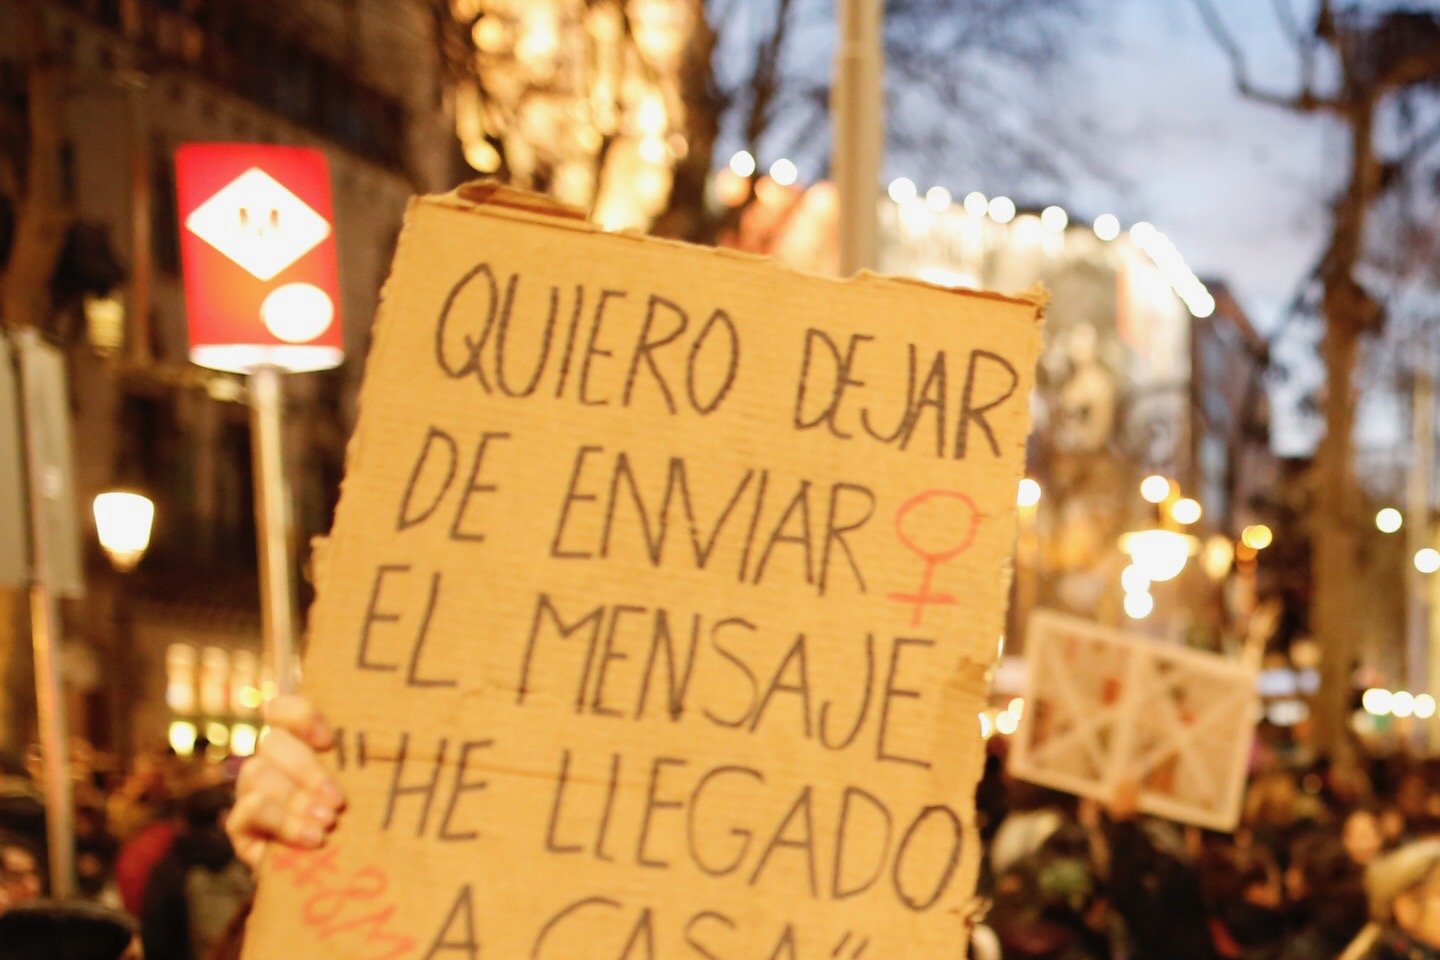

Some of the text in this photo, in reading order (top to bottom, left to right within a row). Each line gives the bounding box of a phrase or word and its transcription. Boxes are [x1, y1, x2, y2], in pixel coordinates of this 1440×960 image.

[434, 261, 1020, 460] QUIERO DEJAR
[395, 425, 876, 596] DE ENVIAR
[355, 563, 936, 770] EL MENSAJE
[543, 746, 964, 912] LLEGADO
